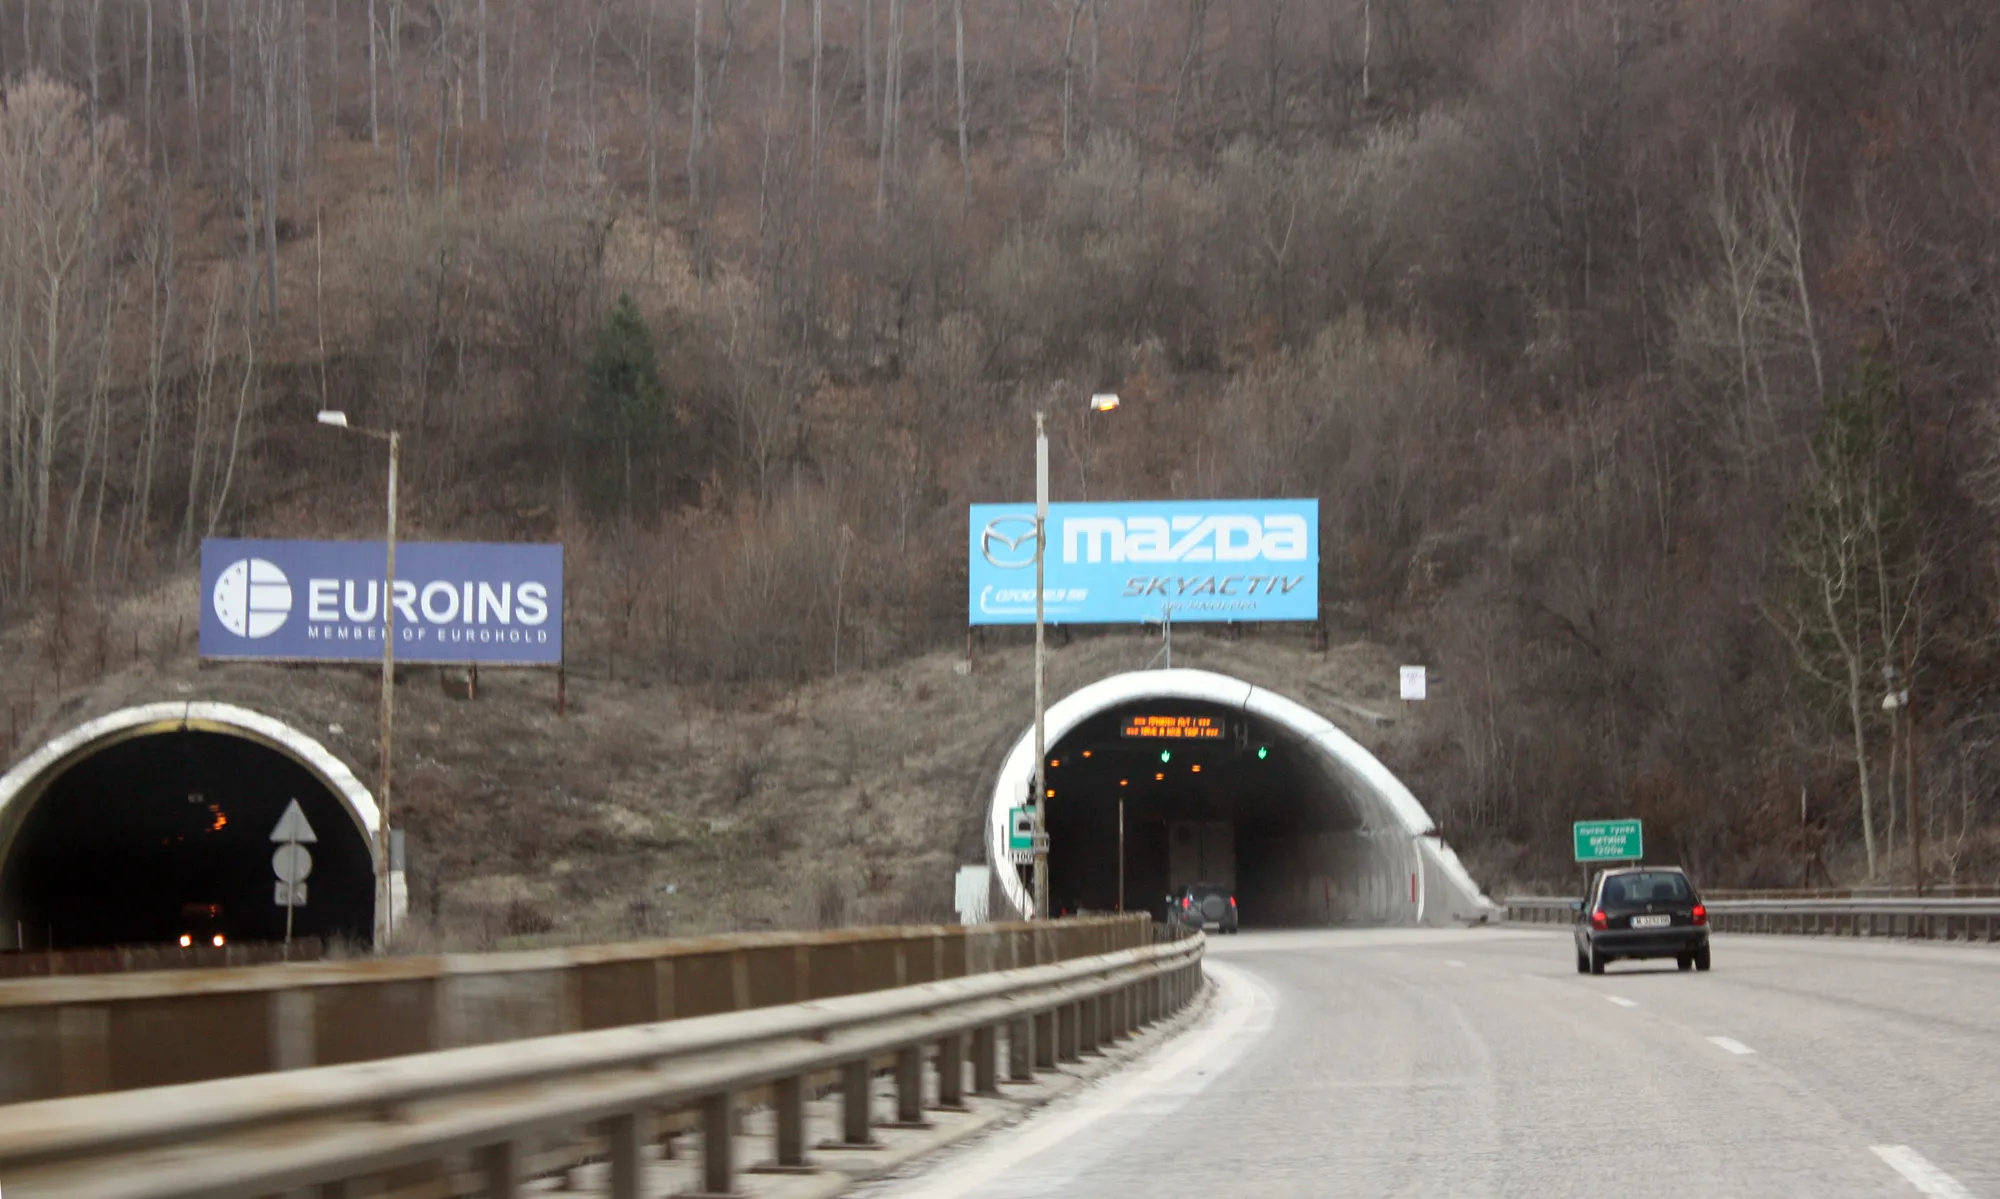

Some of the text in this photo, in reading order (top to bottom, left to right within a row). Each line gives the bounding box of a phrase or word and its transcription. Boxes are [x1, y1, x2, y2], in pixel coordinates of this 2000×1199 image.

[1122, 574, 1305, 597] SKYACTIV
[308, 578, 548, 625] EUROINS
[402, 626, 426, 642] OF
[437, 627, 548, 643] EUROHOLD
